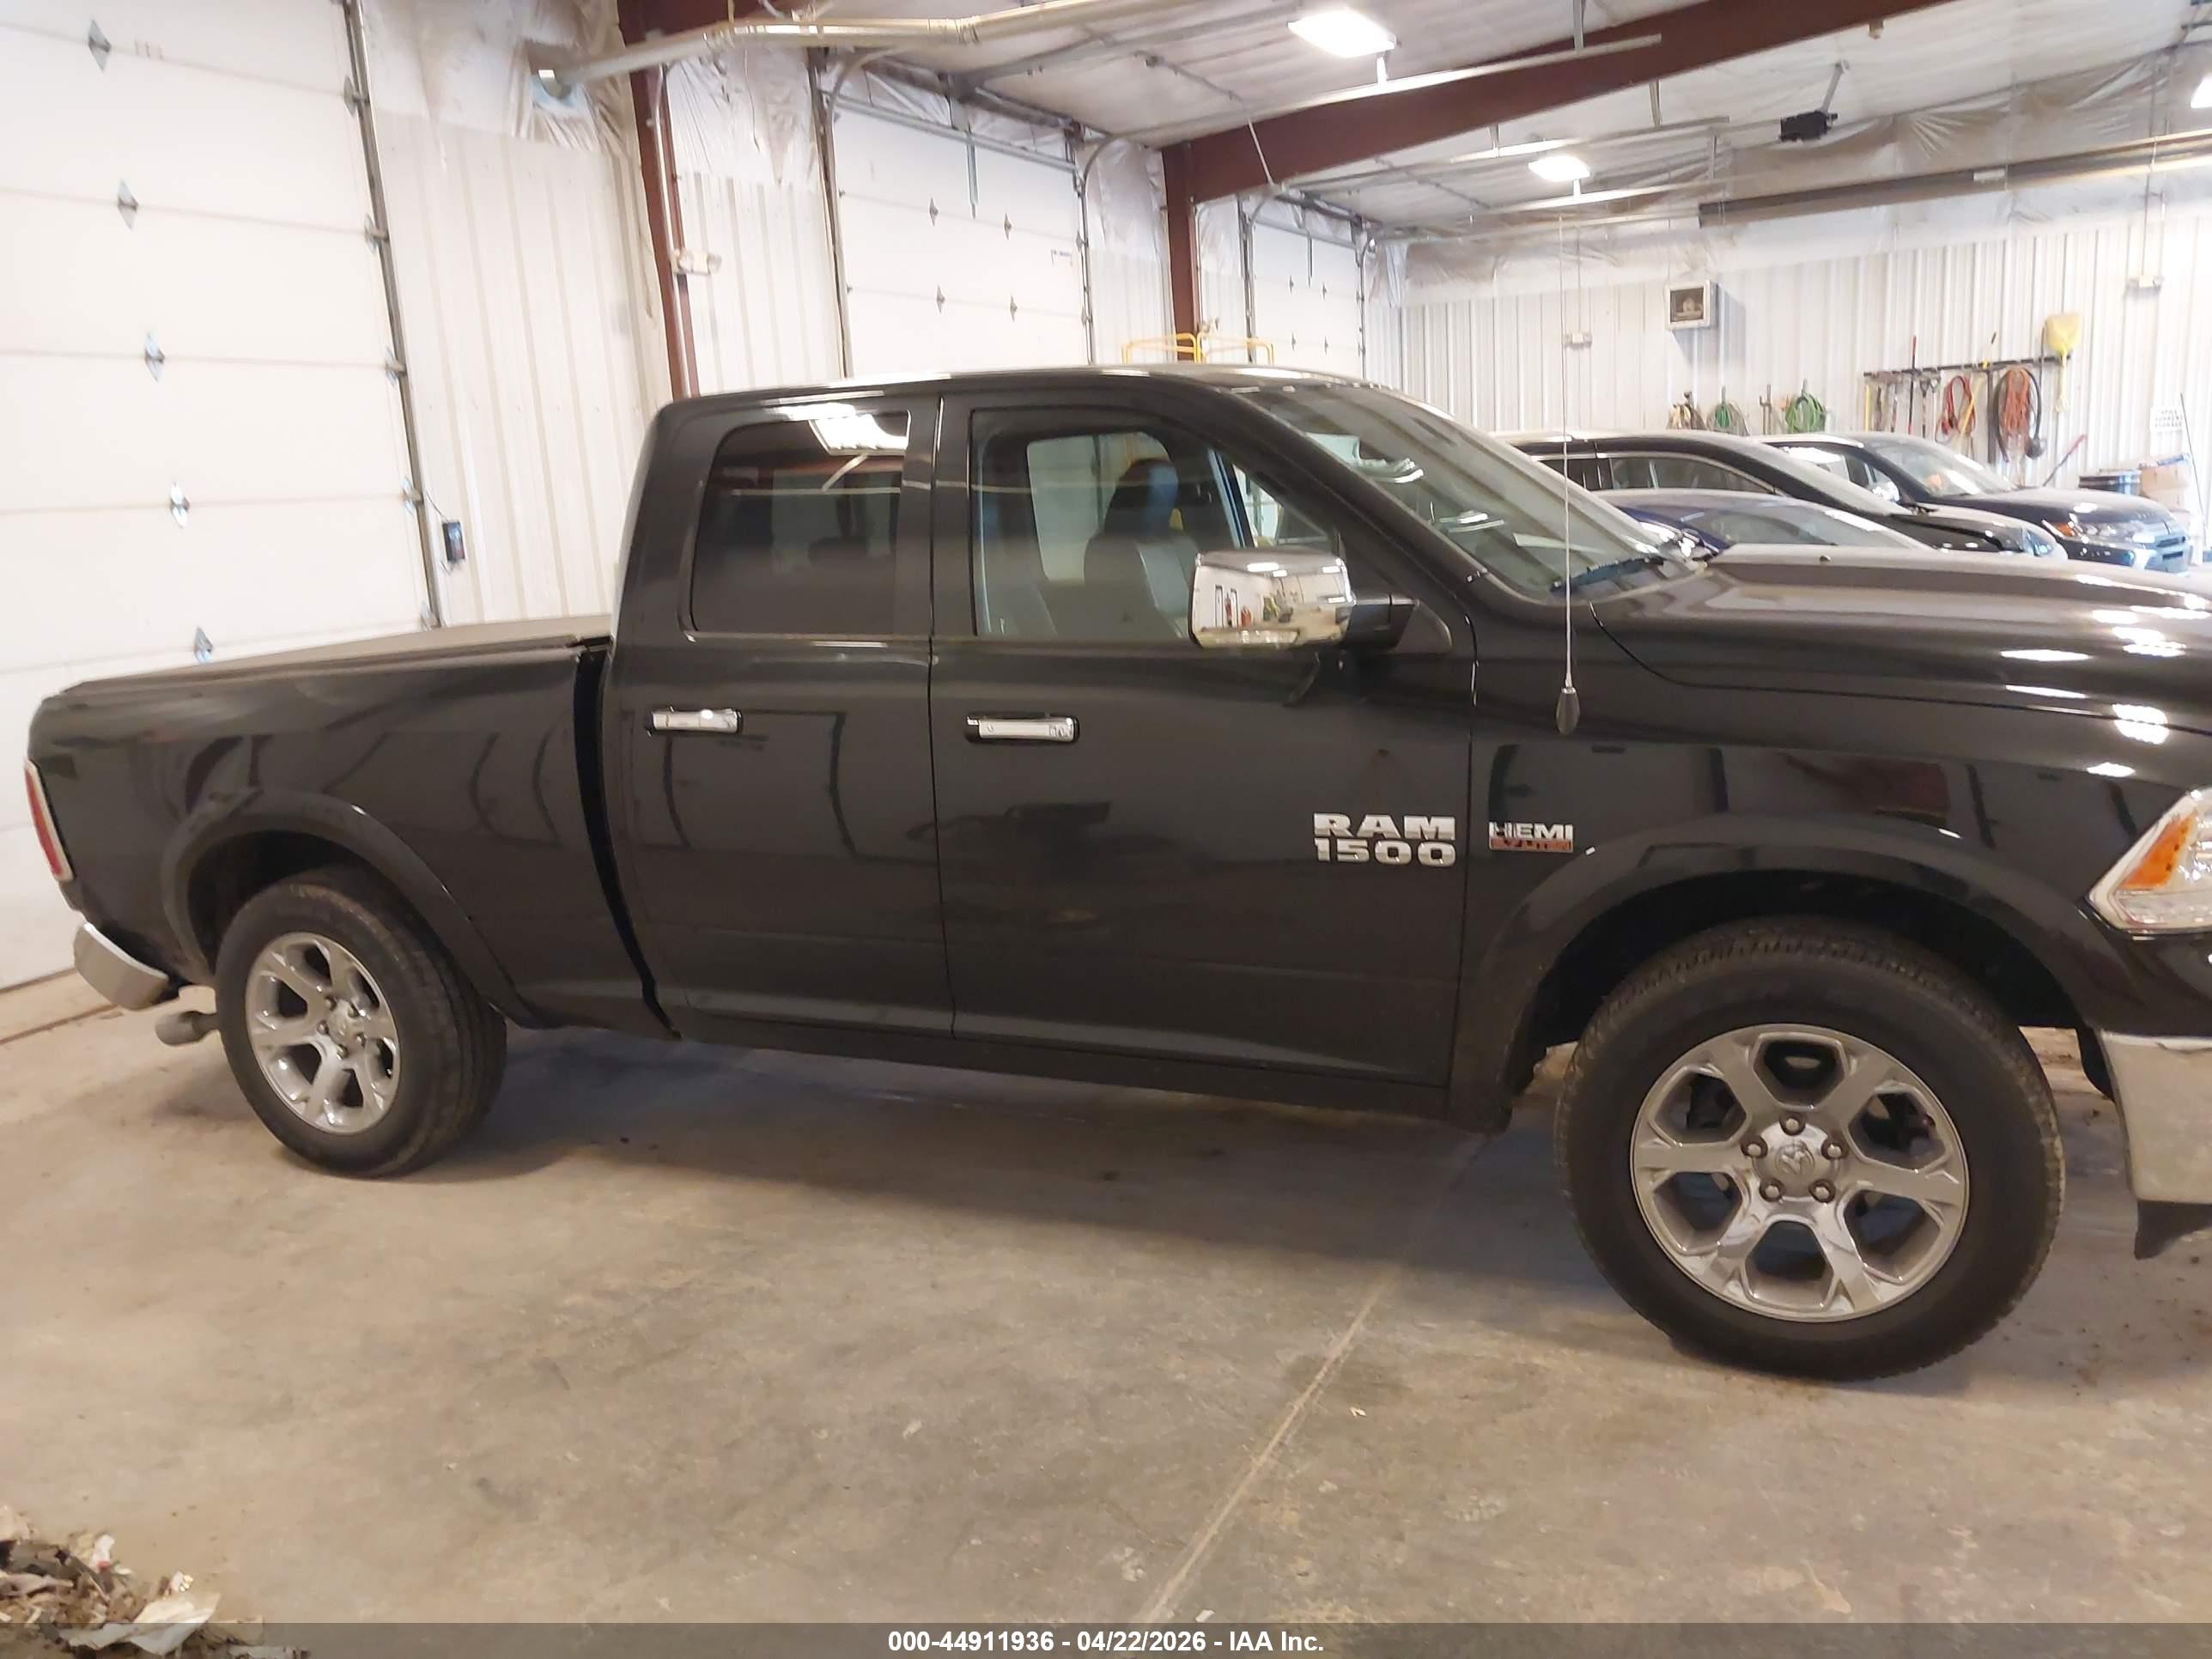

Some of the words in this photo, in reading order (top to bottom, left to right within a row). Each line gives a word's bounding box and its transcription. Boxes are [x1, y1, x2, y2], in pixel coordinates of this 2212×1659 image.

[1313, 811, 1456, 841] RAM
[1488, 821, 1573, 841] HEMI
[1314, 837, 1456, 867] 1500
